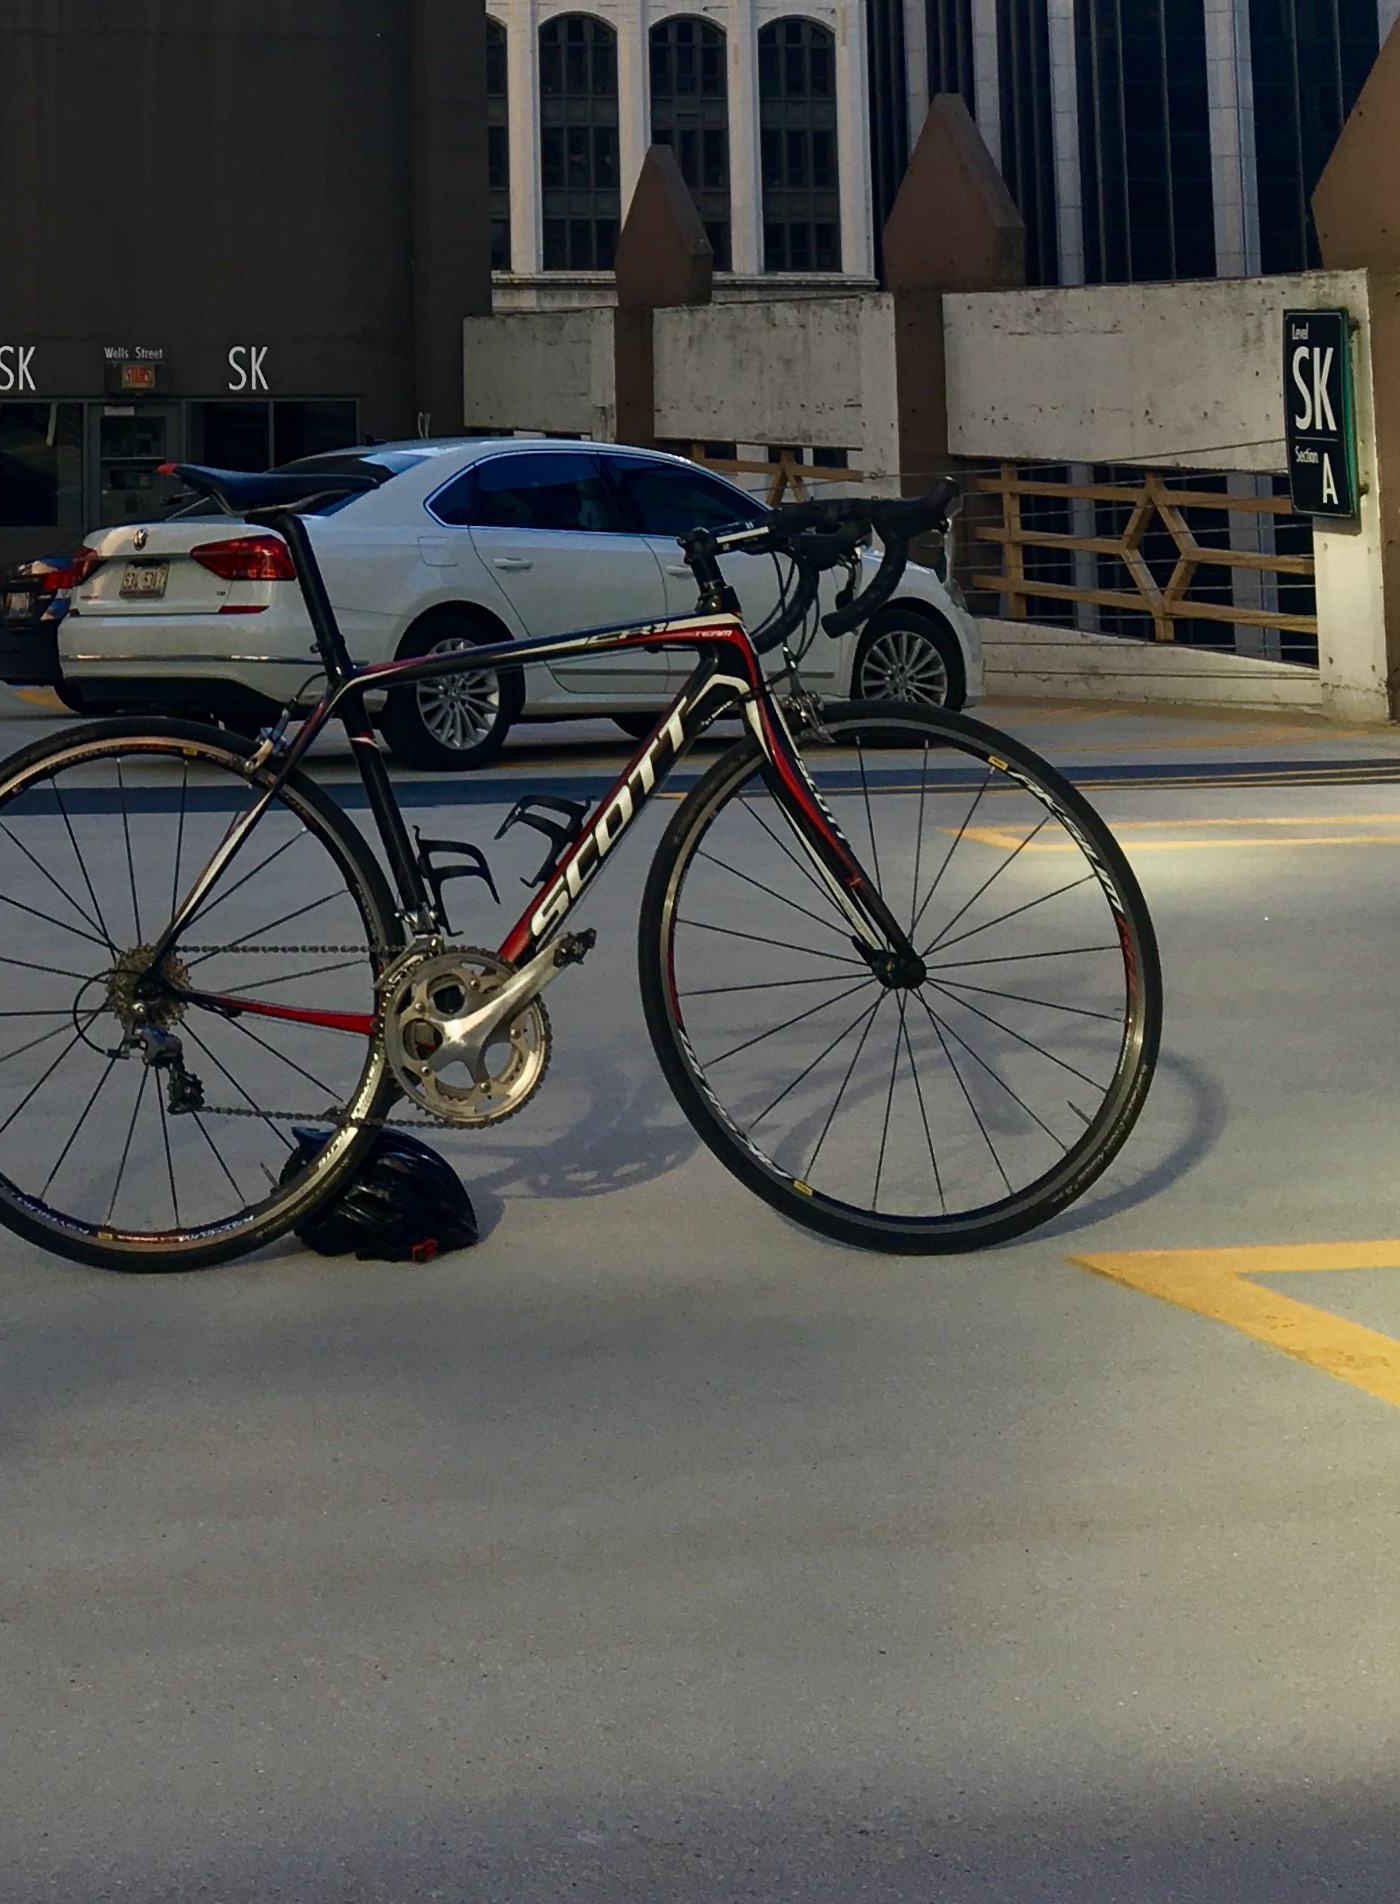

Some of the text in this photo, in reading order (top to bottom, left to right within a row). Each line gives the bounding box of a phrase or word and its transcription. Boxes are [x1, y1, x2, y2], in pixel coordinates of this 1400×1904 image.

[103, 346, 163, 360] Wells Street
[1291, 322, 1310, 341] Level
[227, 345, 269, 391] SK
[1292, 345, 1338, 432] SK
[1294, 445, 1319, 464] Section
[1322, 451, 1339, 505] A
[530, 695, 688, 937] SCOTT
